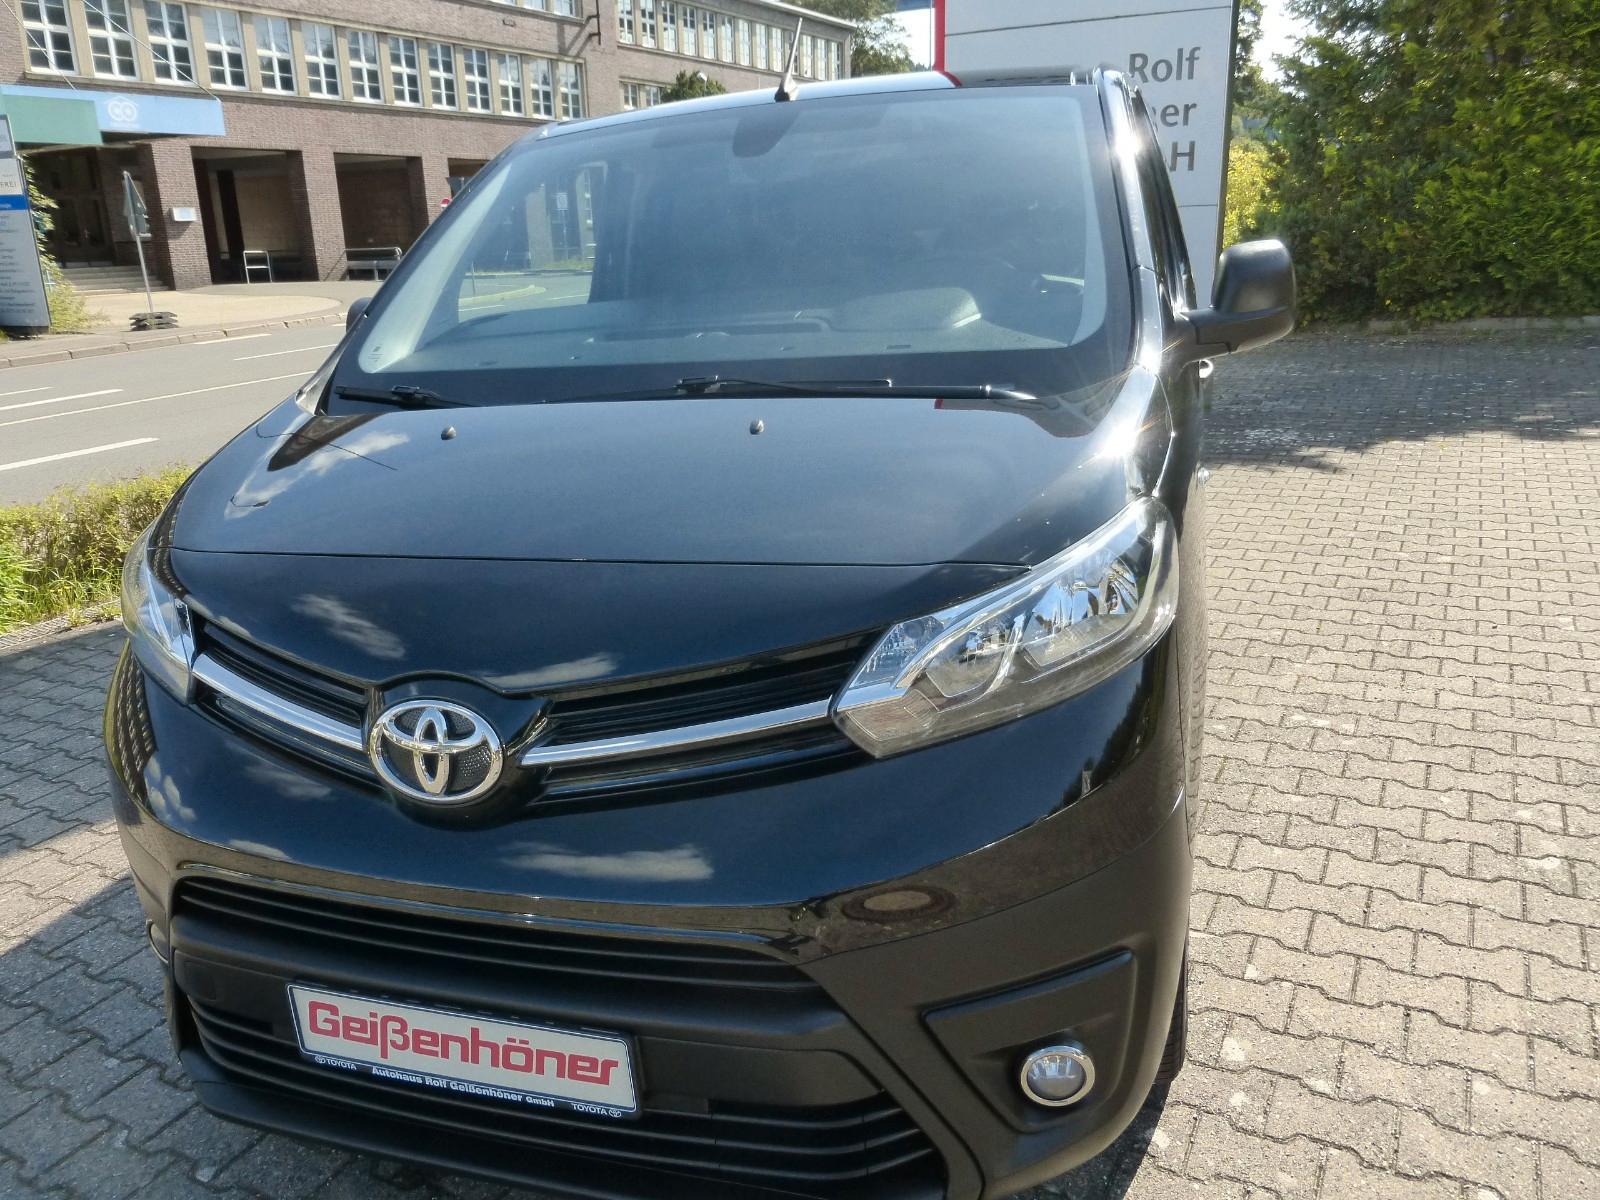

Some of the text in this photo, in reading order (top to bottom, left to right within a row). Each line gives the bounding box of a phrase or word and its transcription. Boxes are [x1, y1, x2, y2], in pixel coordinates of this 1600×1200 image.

[1128, 46, 1201, 83] Rolf
[1152, 102, 1198, 128] er
[308, 1000, 619, 1086] Geißenhöner
[326, 1058, 357, 1071] TOYOTA
[372, 1066, 423, 1085] Autohaus
[425, 1075, 447, 1089] Rolf
[525, 1095, 555, 1108] GmbH
[571, 1102, 608, 1116] TOYOTA
